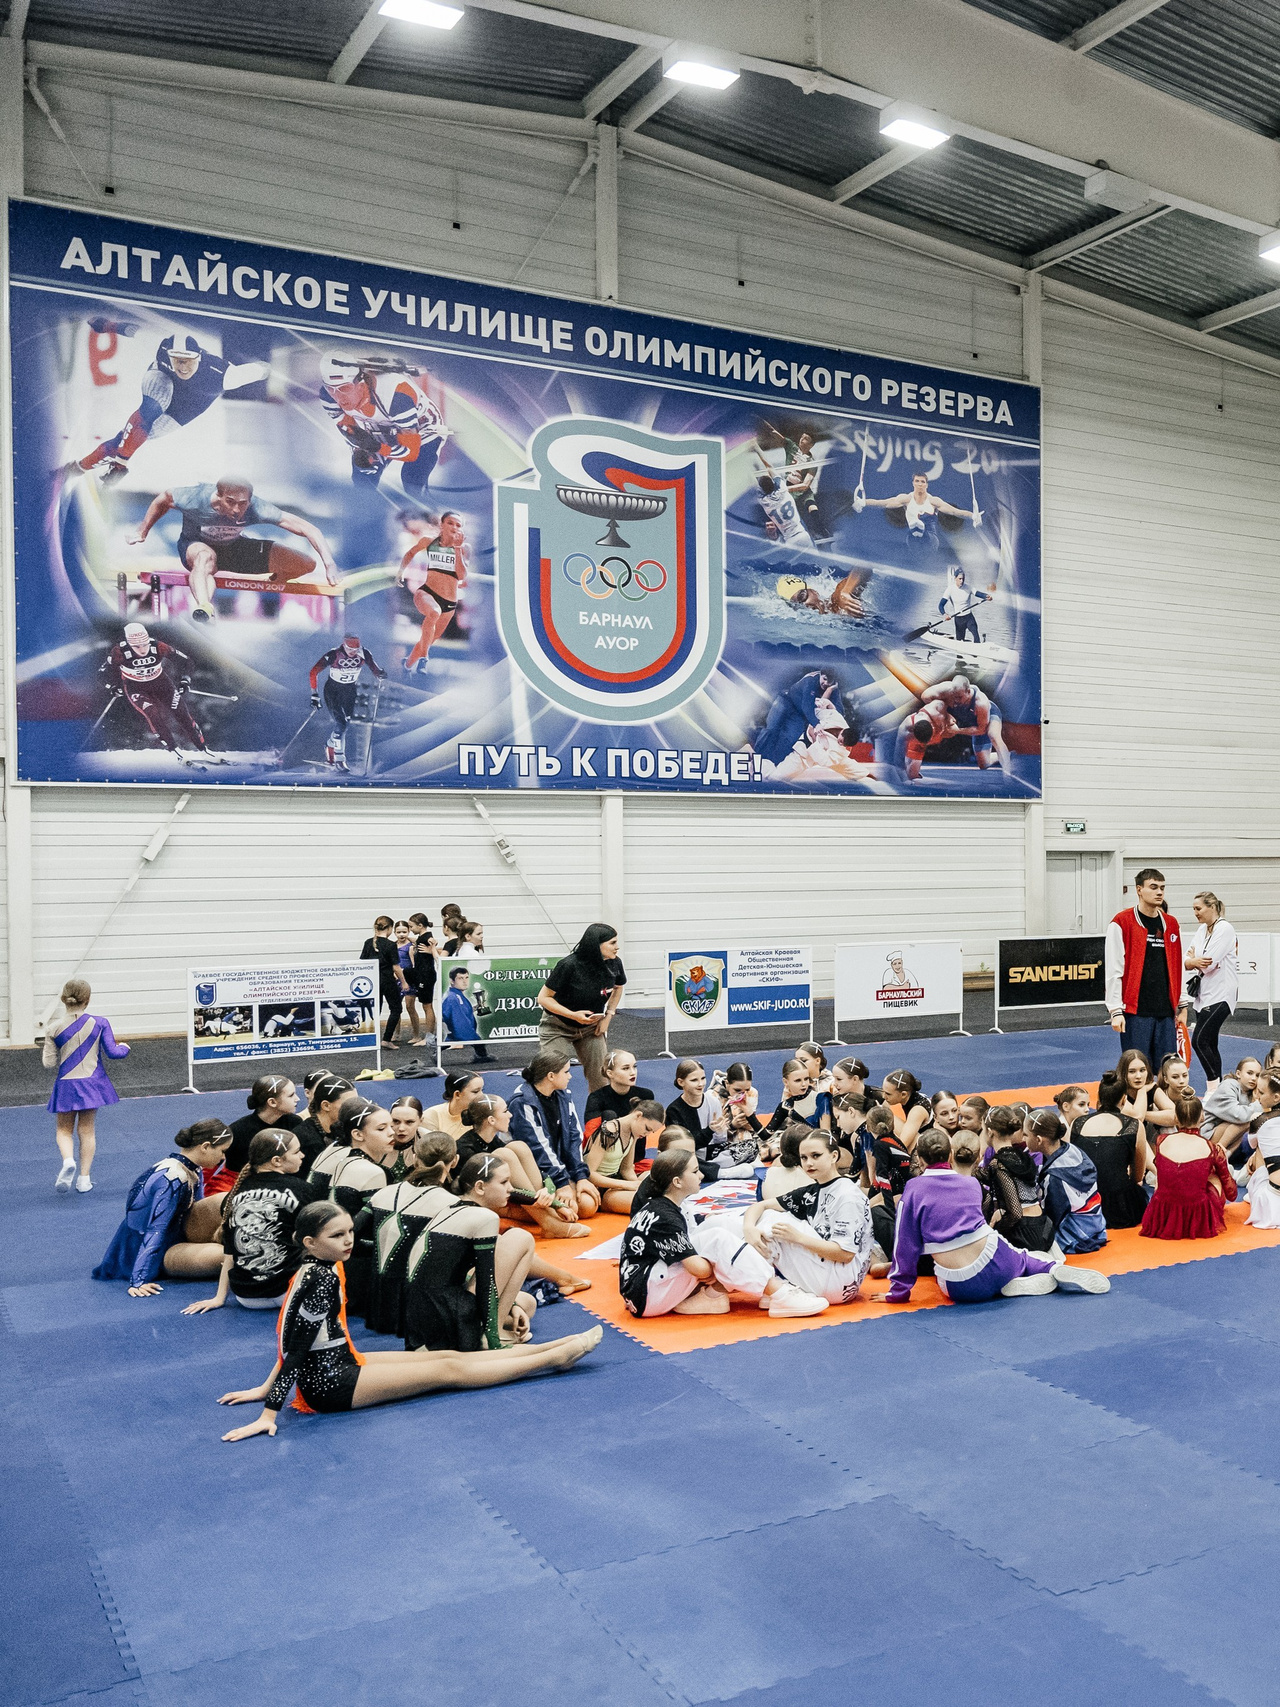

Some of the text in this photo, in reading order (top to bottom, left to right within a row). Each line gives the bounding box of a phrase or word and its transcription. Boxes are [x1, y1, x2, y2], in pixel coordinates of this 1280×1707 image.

[60, 236, 1014, 427] АЛТАЙСКОЕ УЧИЛИЩЕ ОЛИМПИЙСКОГО РЕЗЕРВА
[768, 500, 795, 525] 18
[430, 553, 455, 565] MILLER
[224, 580, 286, 592] LONDON 2017
[578, 610, 654, 630] БАРНАУЛ
[594, 633, 640, 651] АУОР
[458, 743, 763, 786] ПУТЬ К ПОБЕДЕ!
[222, 970, 280, 978] ГОСУДАРСТВЕННОЕ
[319, 965, 375, 973] ОБРАЗОВАТЕЛЬНОЕ
[738, 963, 803, 971] Детская-Юношеская
[769, 969, 810, 977] организация
[1008, 963, 1099, 983] SANCHIST
[243, 990, 297, 999] ОЛИМПИЙСКОГО
[878, 988, 923, 1000] БАРНАУЛЬСКИЙ
[730, 998, 811, 1012] www.SKIF-JUDO.RU
[883, 1000, 918, 1008] ПИЩЕВИК
